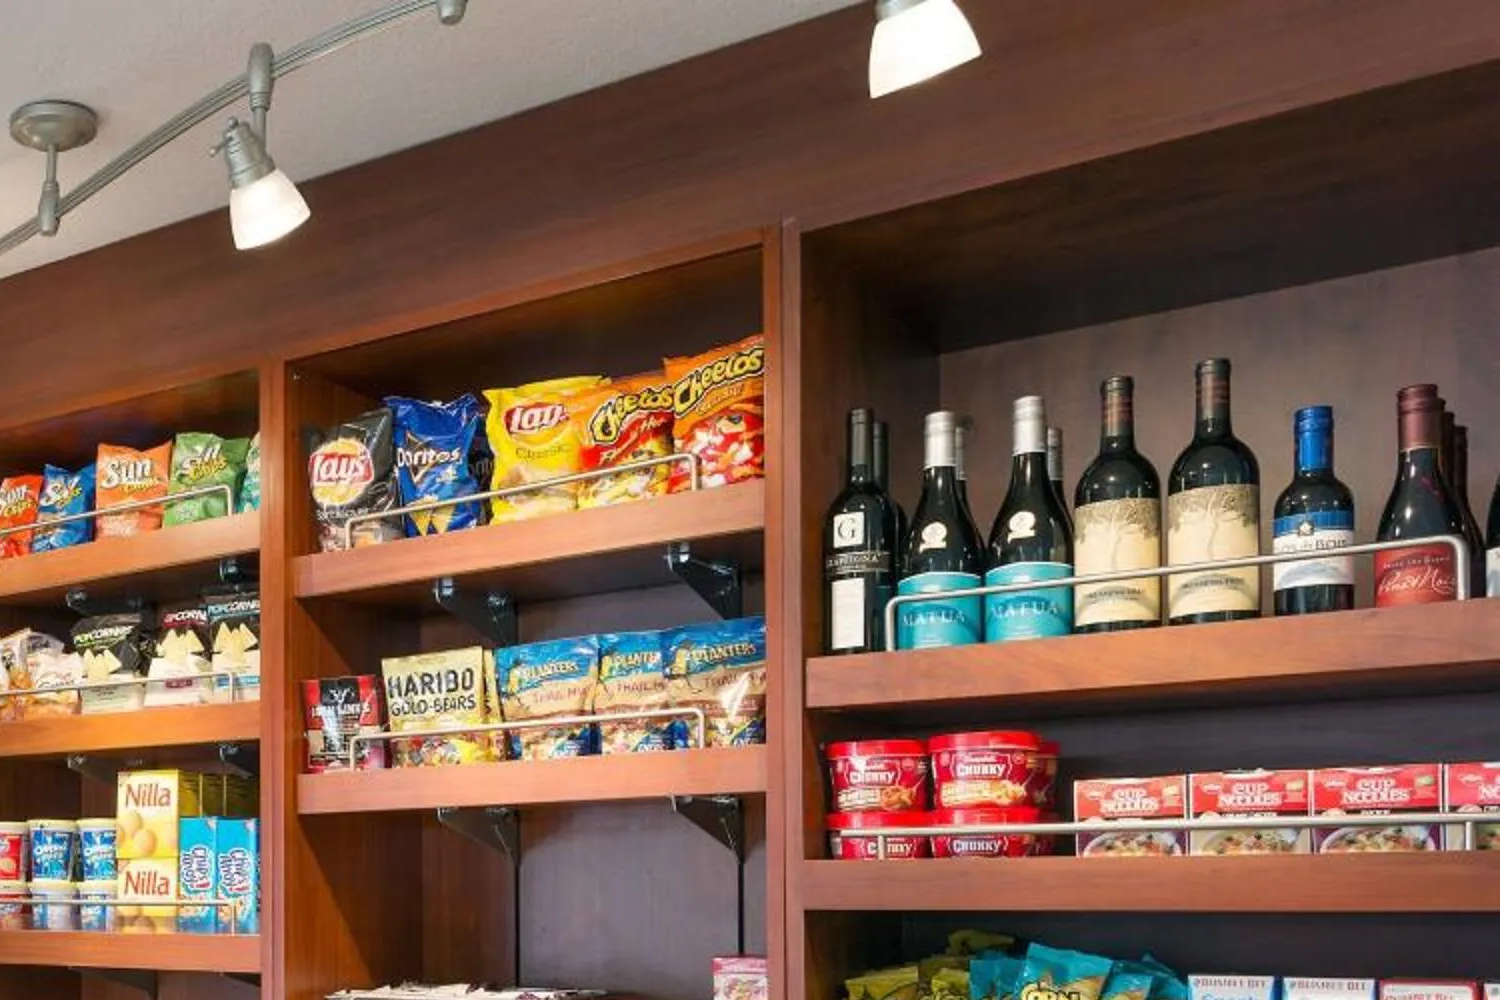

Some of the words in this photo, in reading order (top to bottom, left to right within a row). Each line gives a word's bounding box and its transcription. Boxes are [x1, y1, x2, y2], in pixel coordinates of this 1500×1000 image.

[673, 347, 766, 418] Cheetos
[591, 382, 673, 443] Cheetos
[397, 447, 462, 468] Doritos
[100, 458, 153, 489] Sun
[387, 667, 475, 698] HARIBO
[390, 695, 477, 717] GOLD-BEARS
[957, 763, 1006, 777] CHUNKY
[124, 778, 173, 808] Nilla
[952, 839, 1002, 853] CHUNKY
[124, 868, 171, 896] Nilla
